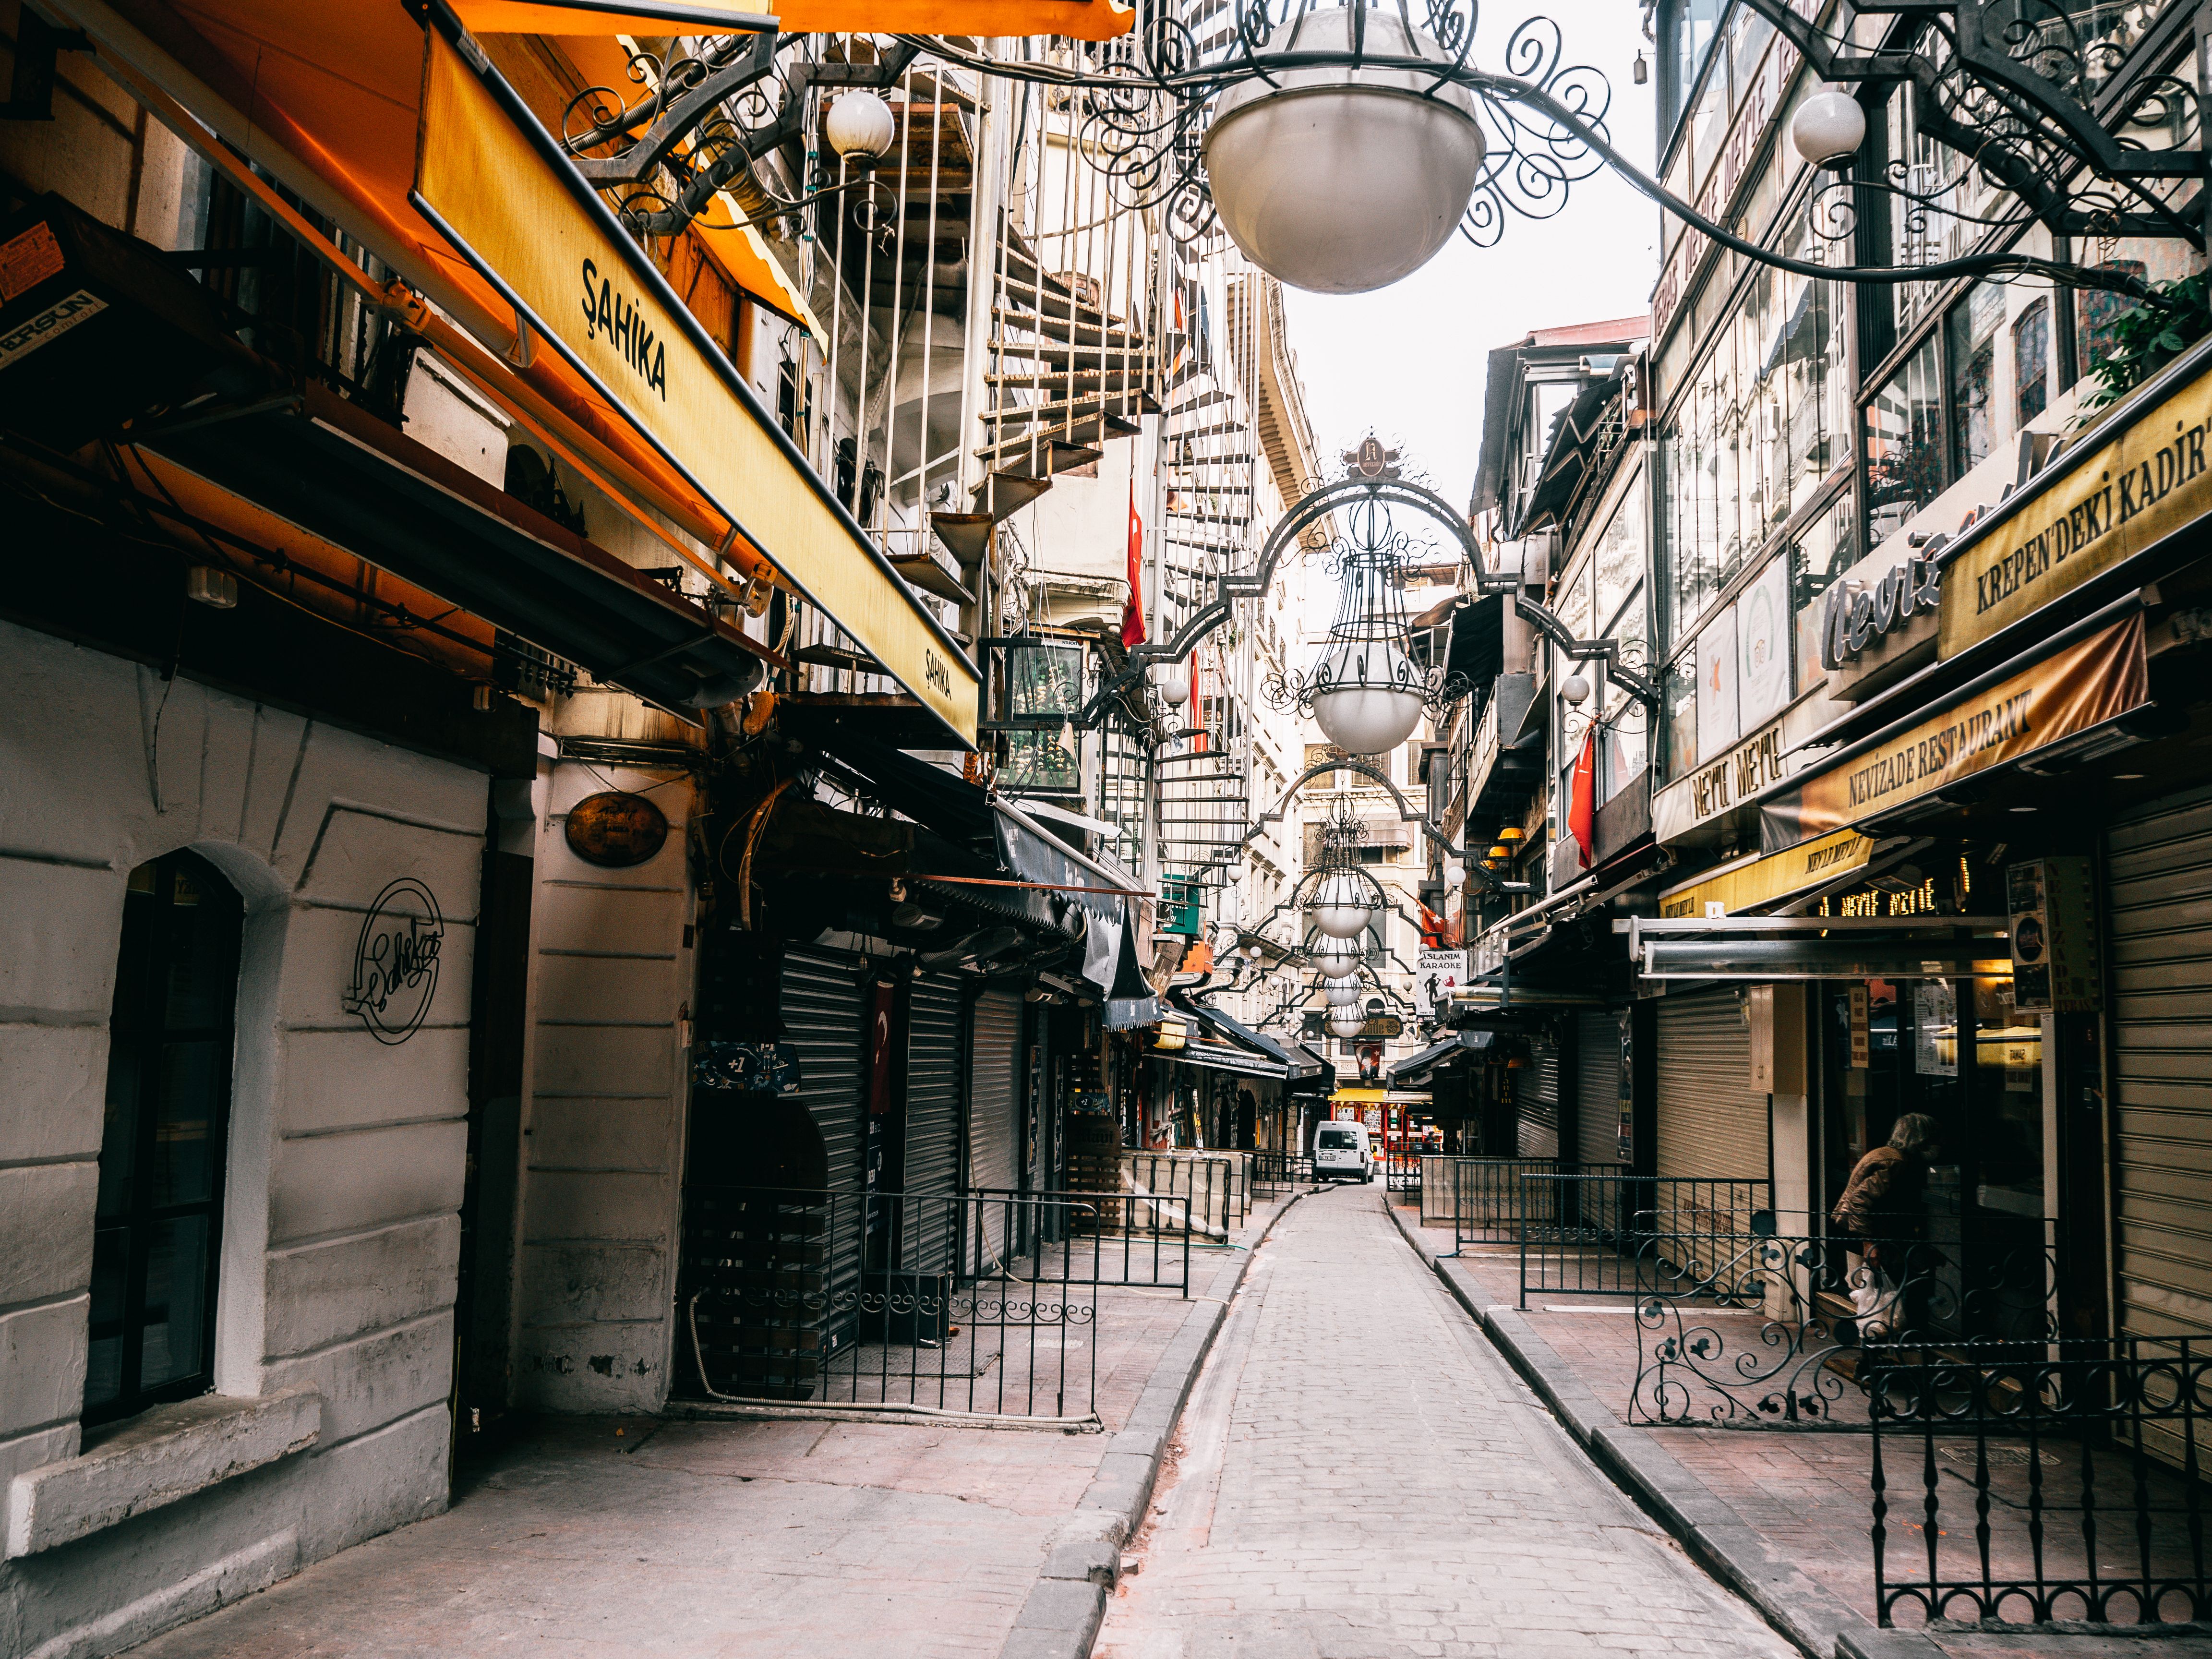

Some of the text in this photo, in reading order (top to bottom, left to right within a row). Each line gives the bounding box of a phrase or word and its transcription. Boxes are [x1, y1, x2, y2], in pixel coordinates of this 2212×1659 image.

[0, 294, 94, 359] ERSUN
[582, 258, 666, 402] ŞAHİKA
[1977, 471, 2113, 615] KREPEN'DEKİ
[926, 648, 951, 701] ŞAHİKA
[1849, 688, 2033, 809] NEVİZADE RESTAURANT
